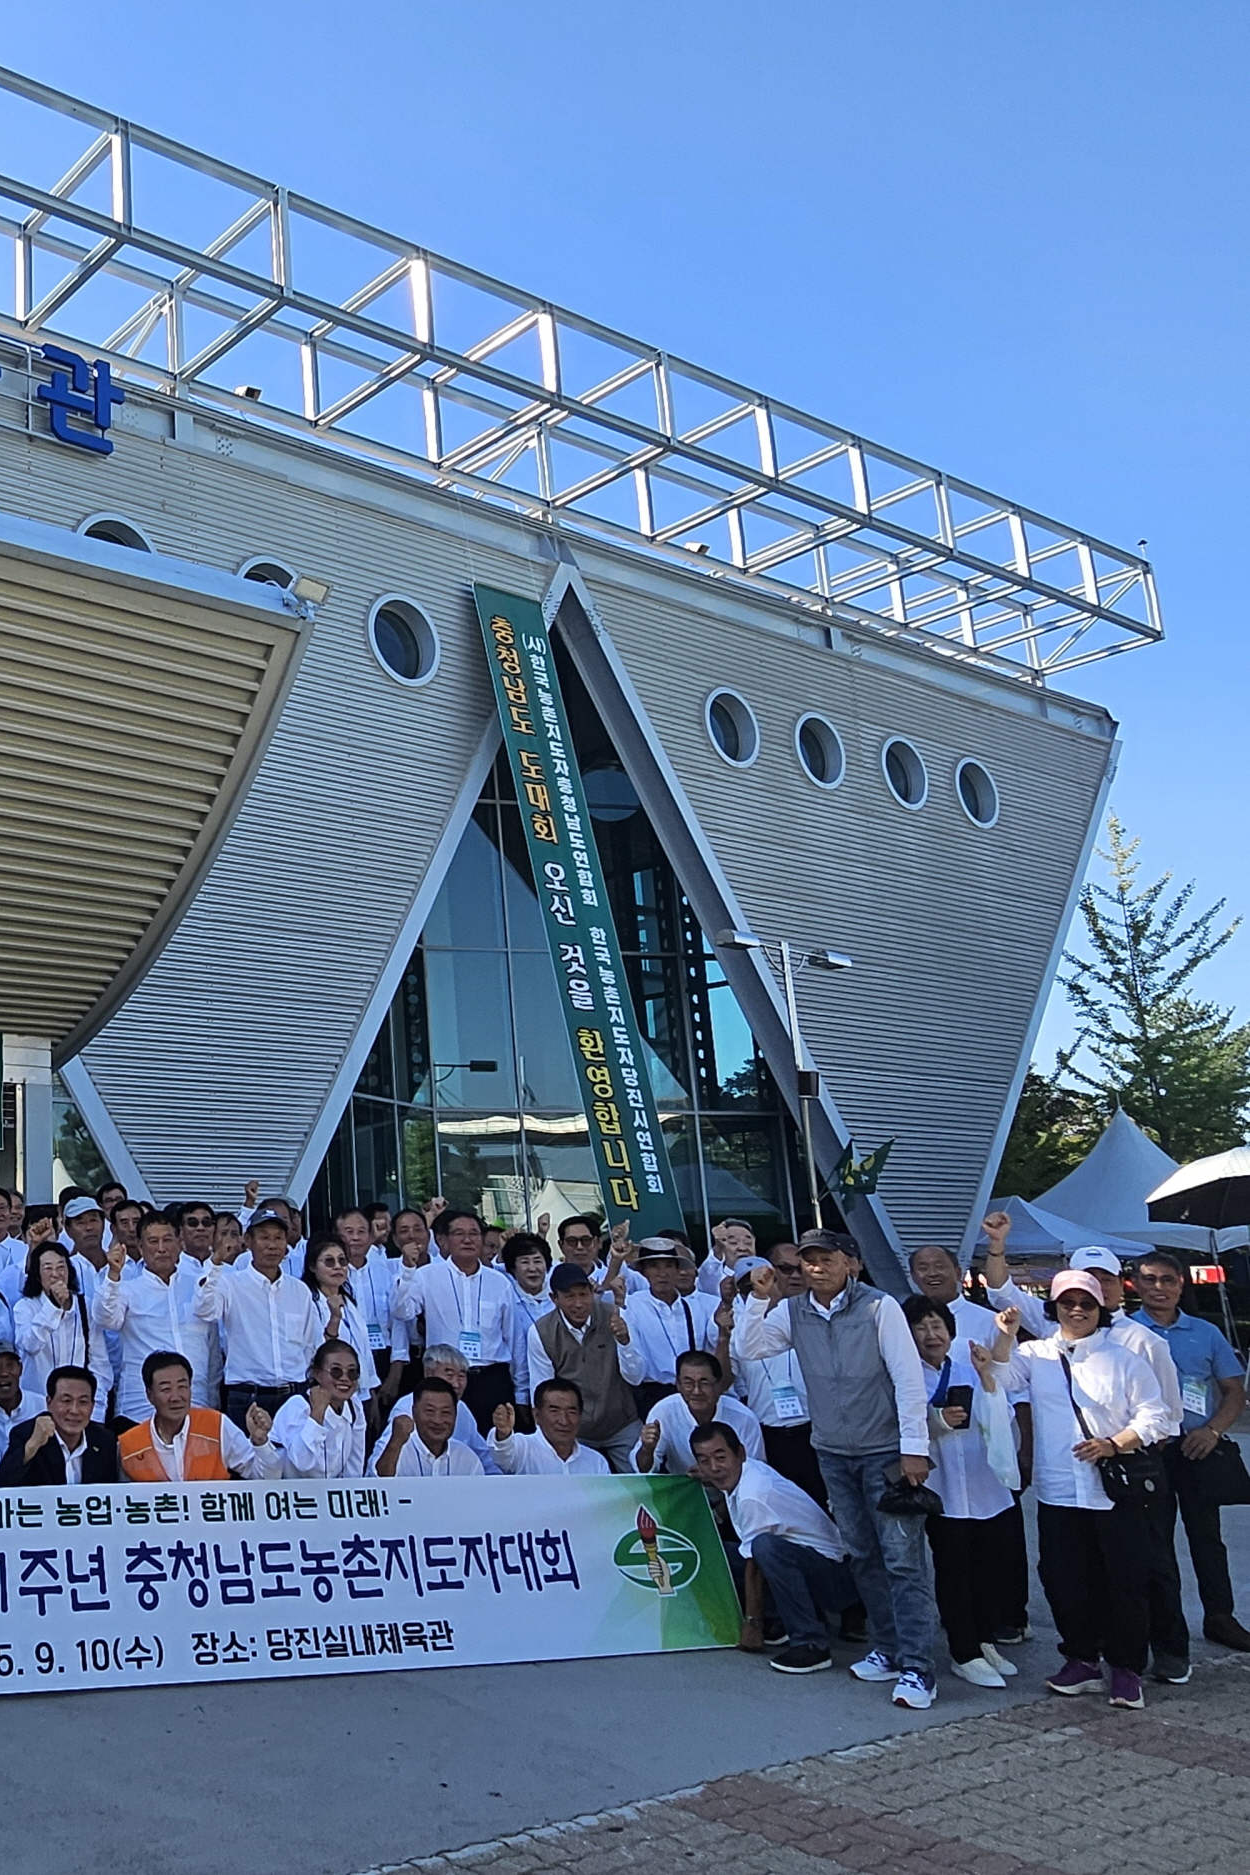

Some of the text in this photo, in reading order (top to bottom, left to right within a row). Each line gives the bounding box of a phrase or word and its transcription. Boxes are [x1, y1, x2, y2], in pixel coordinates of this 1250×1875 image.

[491, 616, 640, 1211] 충청남도 도대회 오신 것을 환영합니다
[588, 926, 665, 1195] 한국농촌지도자당진시연합회
[54, 1493, 190, 1528] 농업·농촌!
[201, 1490, 256, 1524] 함께
[265, 1489, 319, 1521] 여는
[327, 1488, 390, 1520] 미래!
[123, 1528, 581, 1612] 충청남도농촌지도자대회
[75, 1635, 165, 1671] 10(수)
[191, 1630, 258, 1667] 장소:
[265, 1619, 456, 1662] 당진실내체육관
